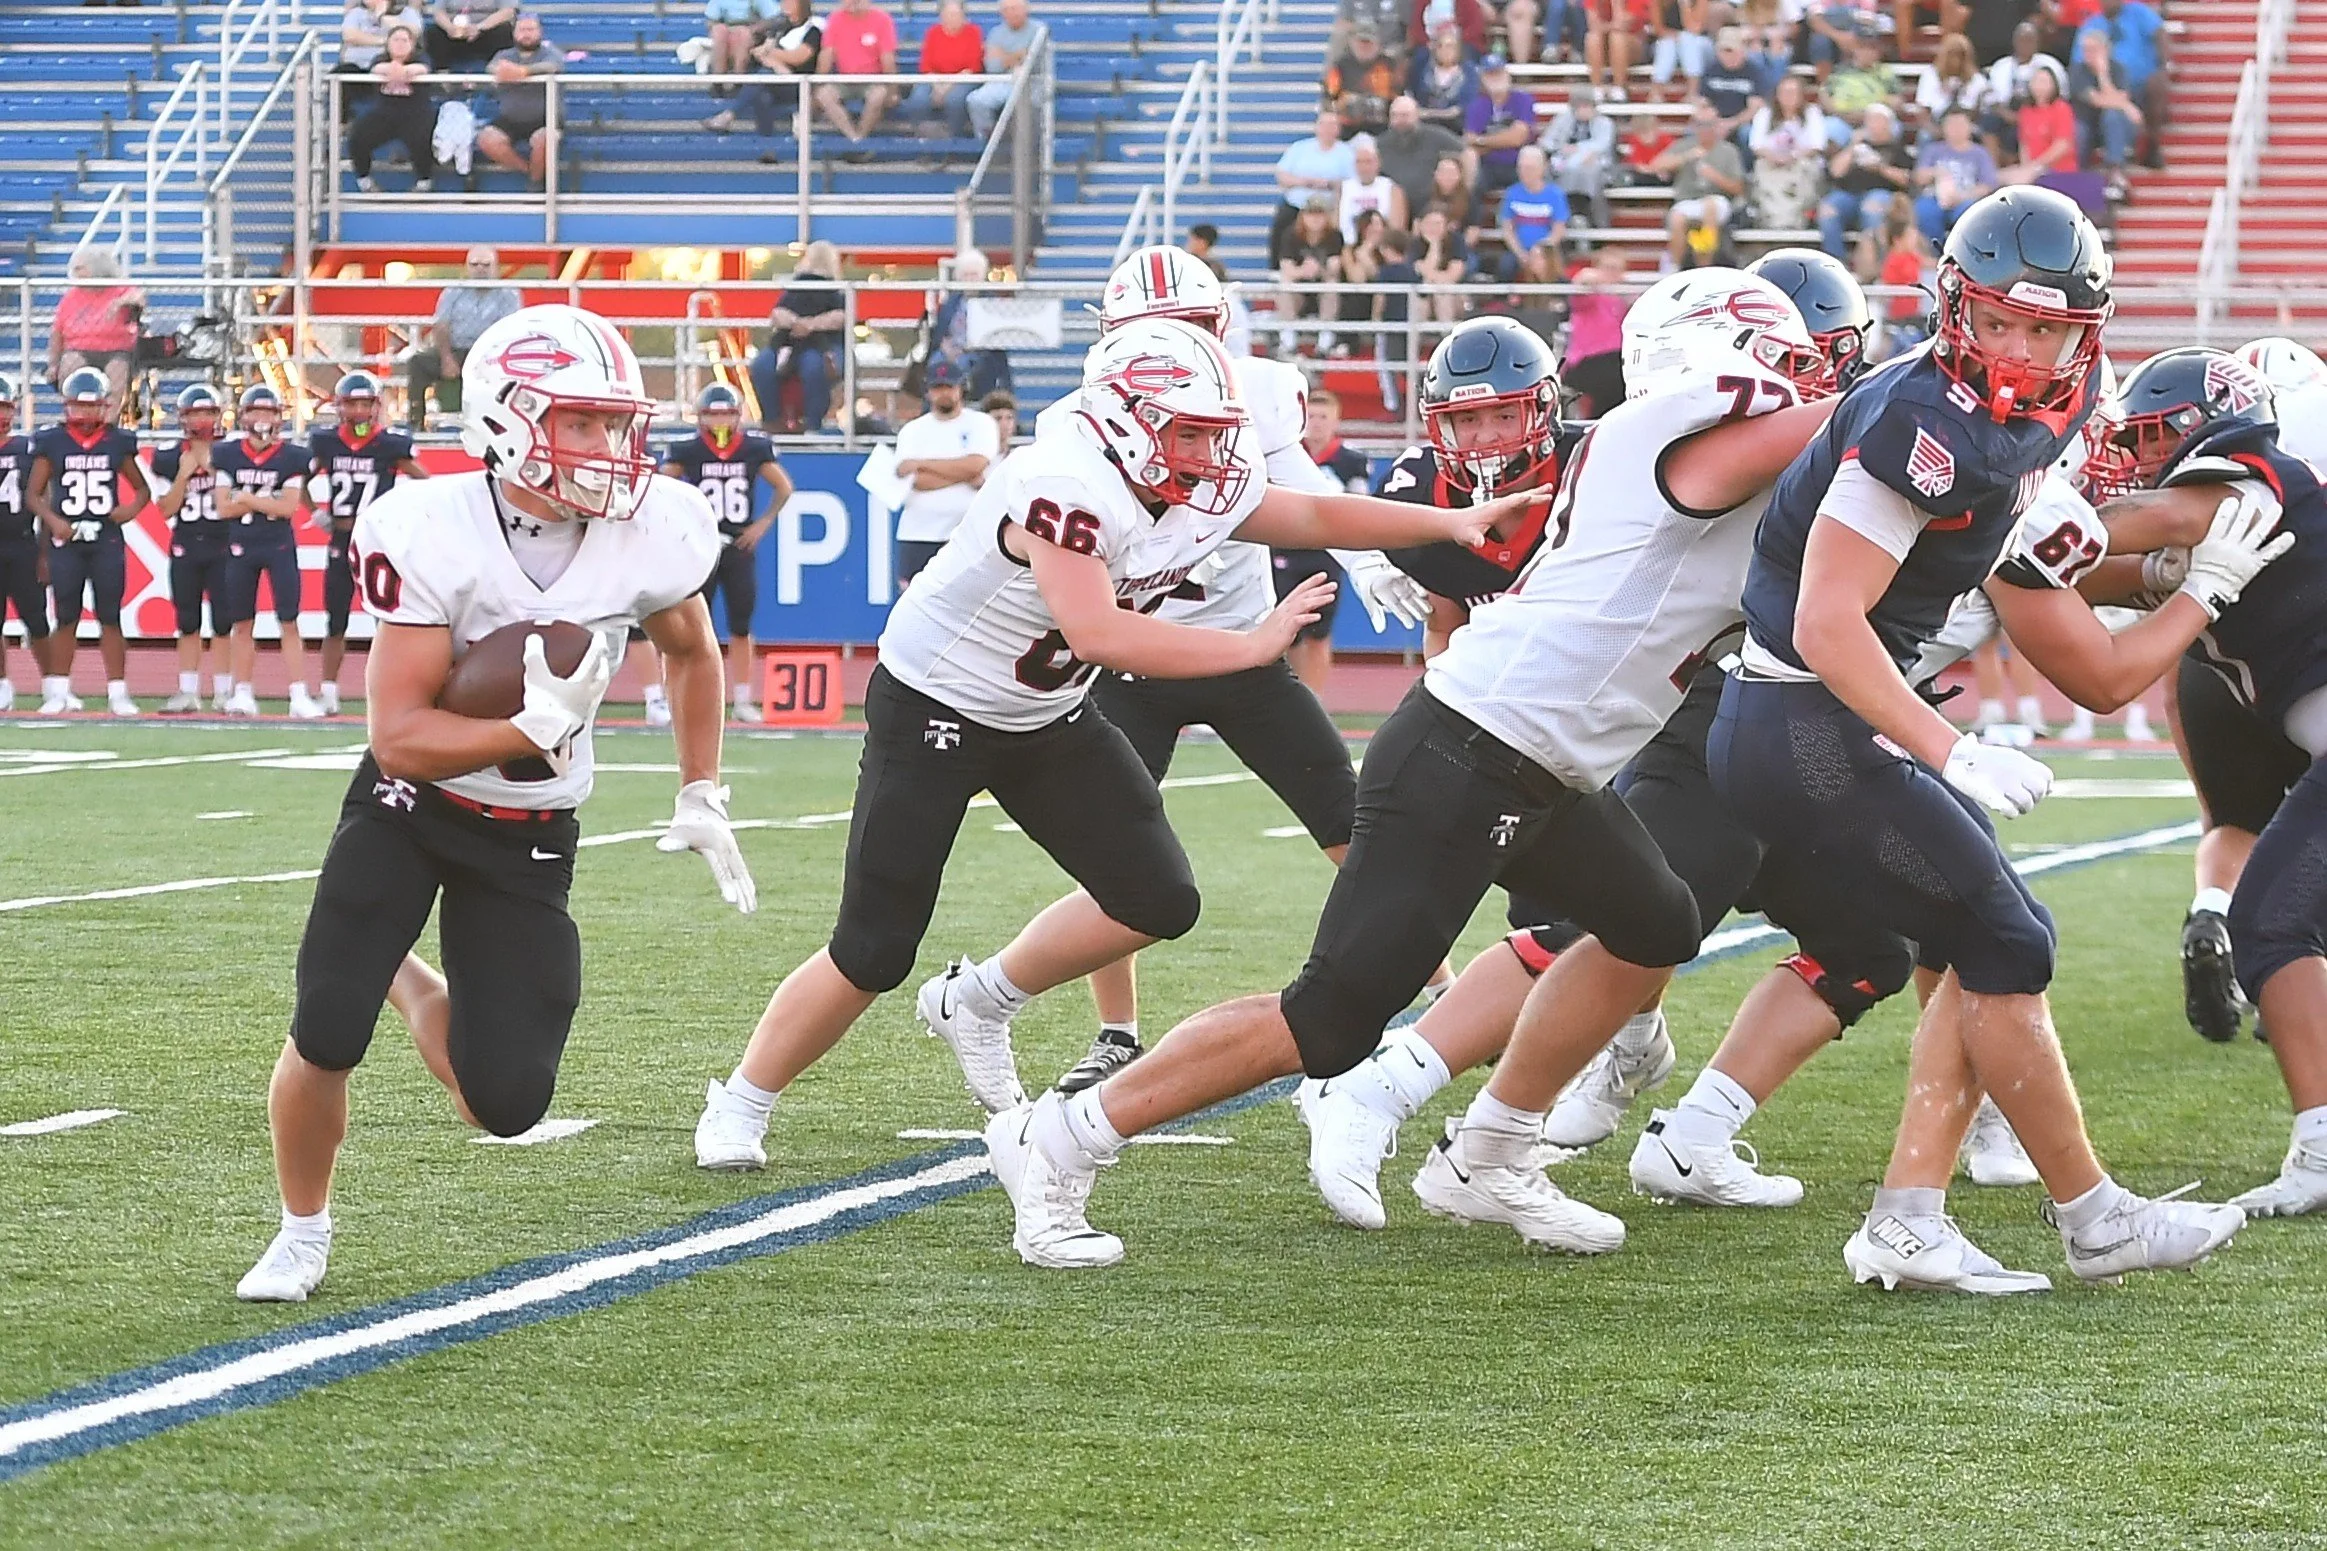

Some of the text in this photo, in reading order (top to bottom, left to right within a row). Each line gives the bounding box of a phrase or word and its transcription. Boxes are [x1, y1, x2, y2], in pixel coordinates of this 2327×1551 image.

[2025, 286, 2058, 299] NATION
[1455, 387, 1487, 397] NATION
[64, 454, 110, 470] INDIANS
[332, 457, 375, 471] INDIANS
[701, 462, 746, 477] INDIANS
[61, 471, 113, 516] 35
[236, 469, 279, 487] INDIANS
[331, 472, 379, 517] 27
[1025, 497, 1101, 556] 66
[2032, 520, 2104, 586] 67
[772, 663, 828, 711] 30
[1871, 1215, 1926, 1260] NIKE
